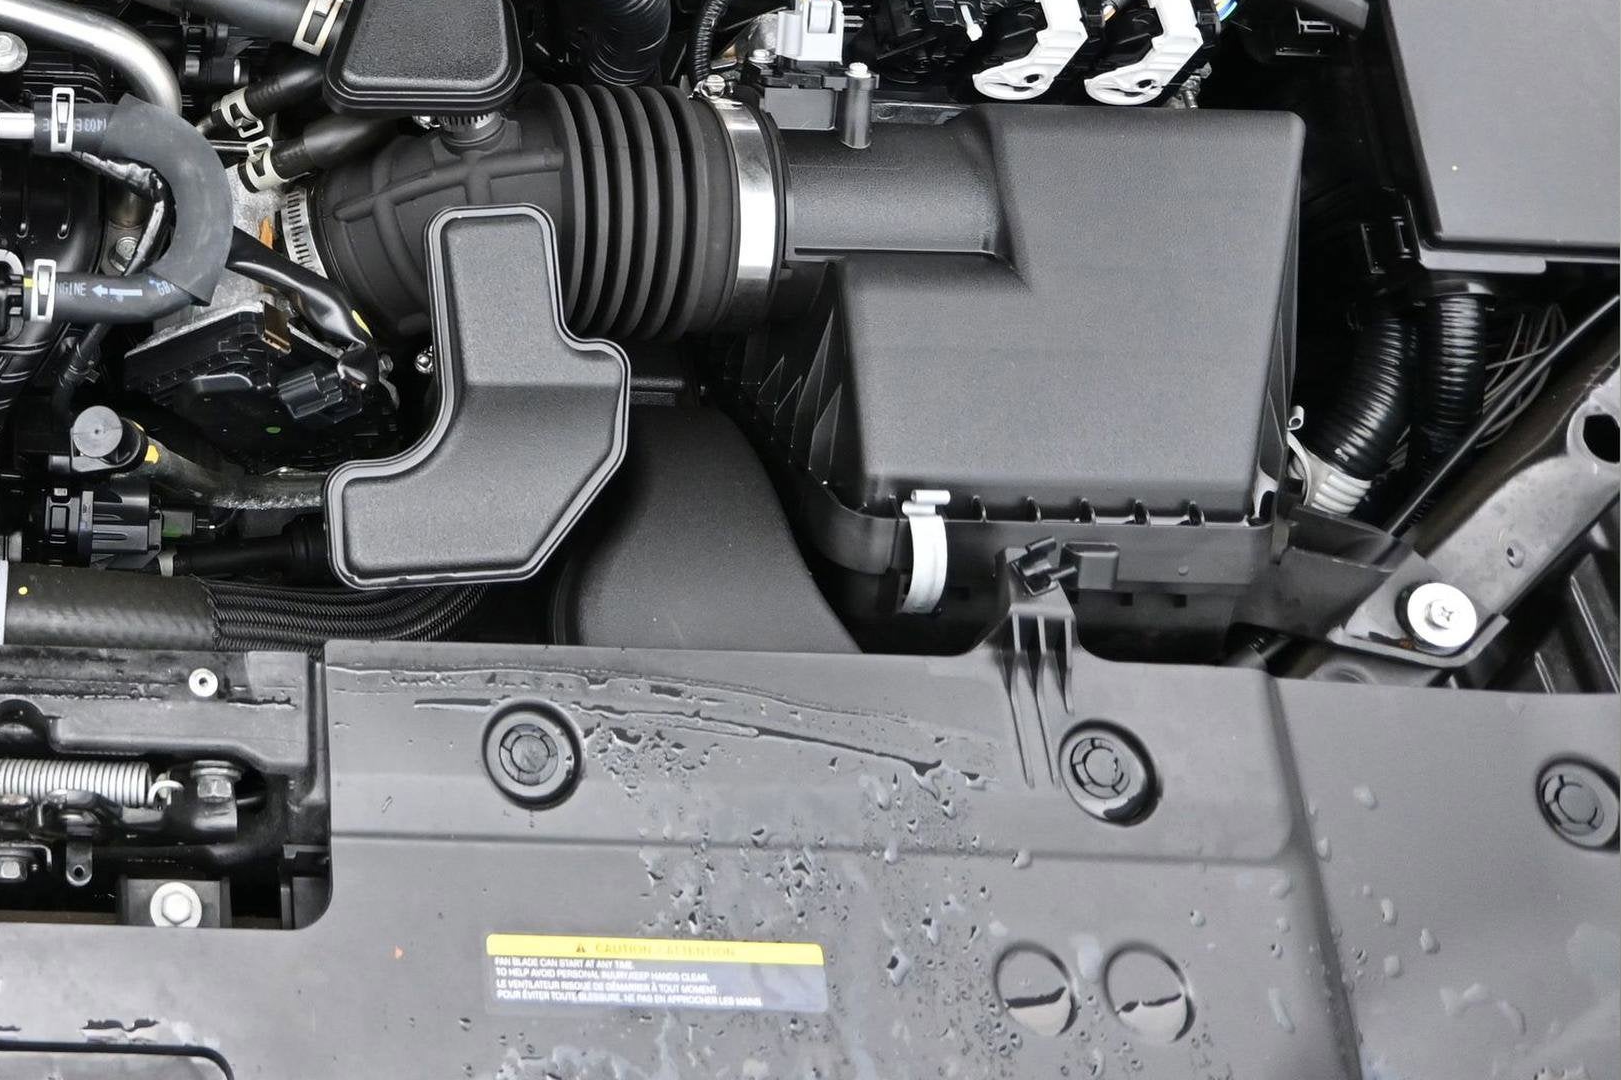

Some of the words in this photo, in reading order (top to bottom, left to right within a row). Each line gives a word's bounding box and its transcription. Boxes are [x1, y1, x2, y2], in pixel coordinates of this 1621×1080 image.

[56, 281, 86, 296] NGINE
[596, 945, 651, 954] CAUTION
[495, 957, 510, 965] FAN
[512, 957, 538, 966] BLADE
[540, 958, 557, 967] CAN
[559, 959, 583, 968] START
[585, 959, 594, 968] AT
[597, 960, 612, 968] ANY
[496, 967, 507, 976] TO
[509, 968, 529, 977] HELP
[531, 969, 555, 977] AVOID
[556, 969, 599, 979] PERSONAL
[496, 979, 506, 988] LE
[508, 979, 559, 989] VENTILATEUR
[659, 983, 679, 993] TOUT
[496, 990, 521, 999] POUR
